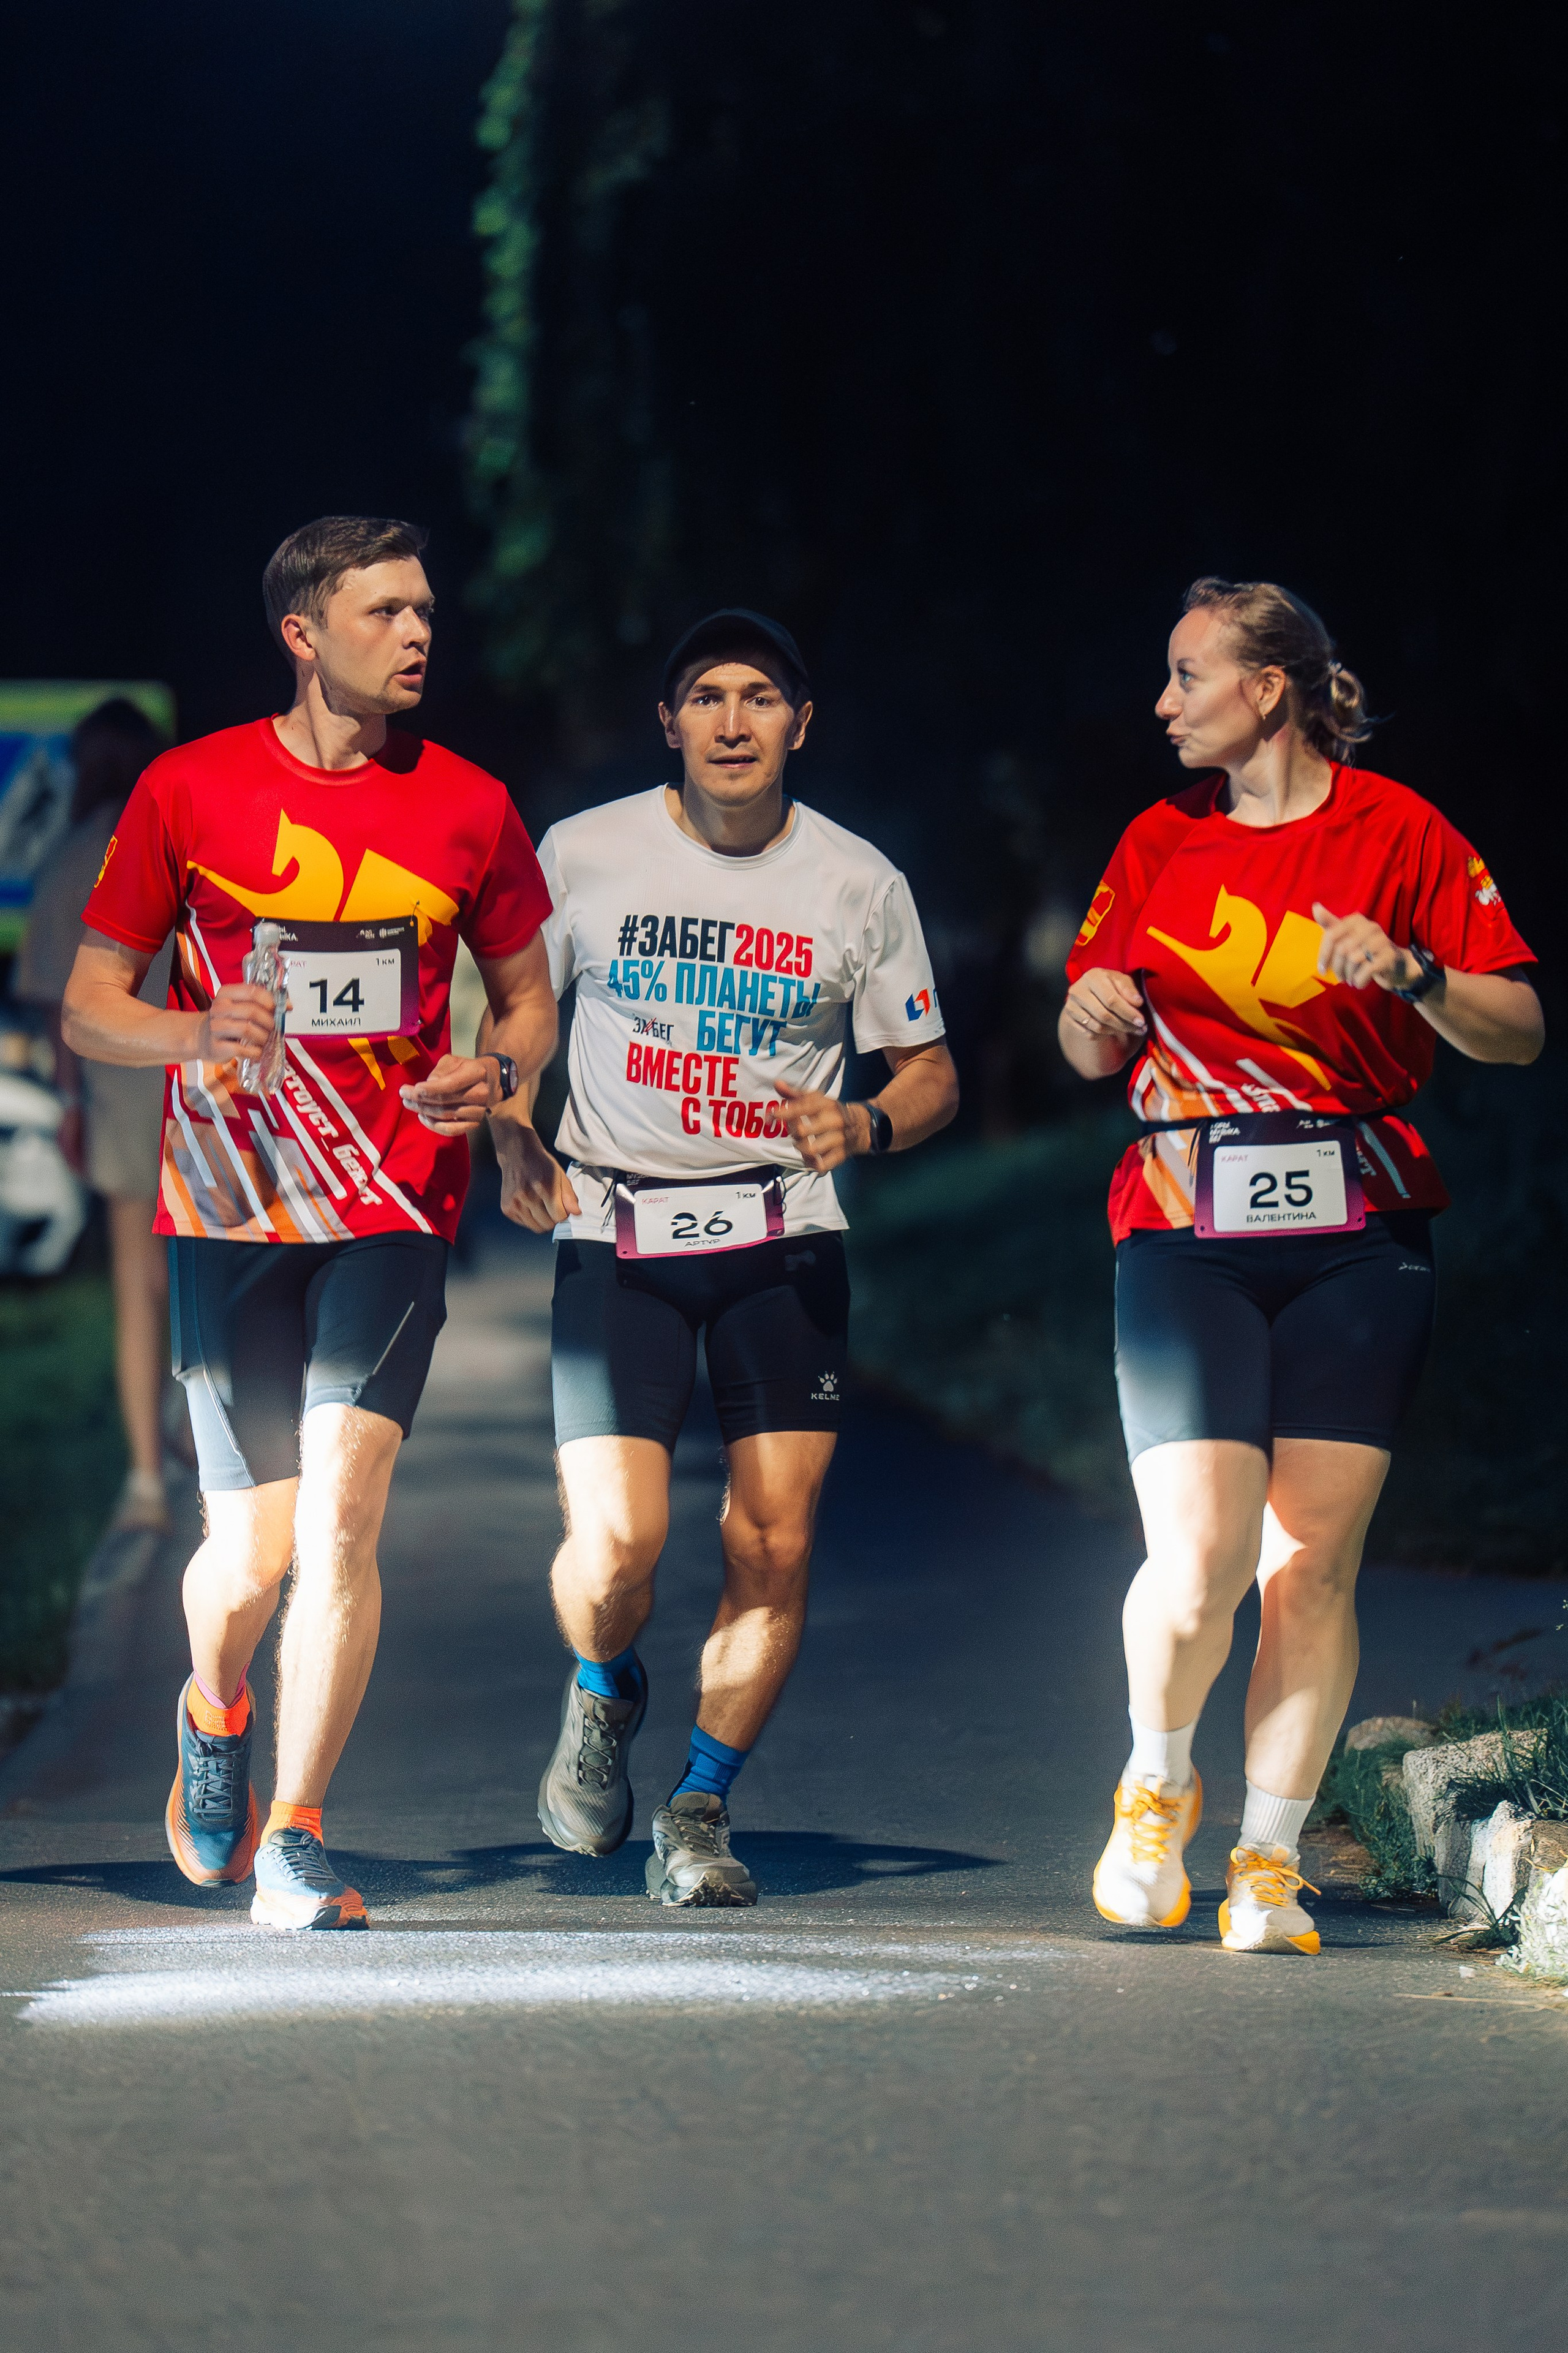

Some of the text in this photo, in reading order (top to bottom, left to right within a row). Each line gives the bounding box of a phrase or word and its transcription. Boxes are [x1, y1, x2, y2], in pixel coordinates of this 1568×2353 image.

[290, 960, 307, 969] РАТ
[375, 957, 380, 966] 1
[617, 914, 813, 978] #ЗАБЕГ2025
[309, 977, 365, 1014] 14
[607, 959, 821, 1019] 45% ПЛАНЕТЫ
[311, 1017, 362, 1028] МИХАИЛ
[696, 1010, 787, 1057] БЕГУТ
[625, 1041, 739, 1098] ВМЕСТЕ
[681, 1097, 701, 1135] С
[1249, 1169, 1313, 1209] 25
[671, 1210, 733, 1239] 26
[1246, 1212, 1317, 1223] ВАЛЕНТИНА
[810, 1392, 840, 1401] KELME
